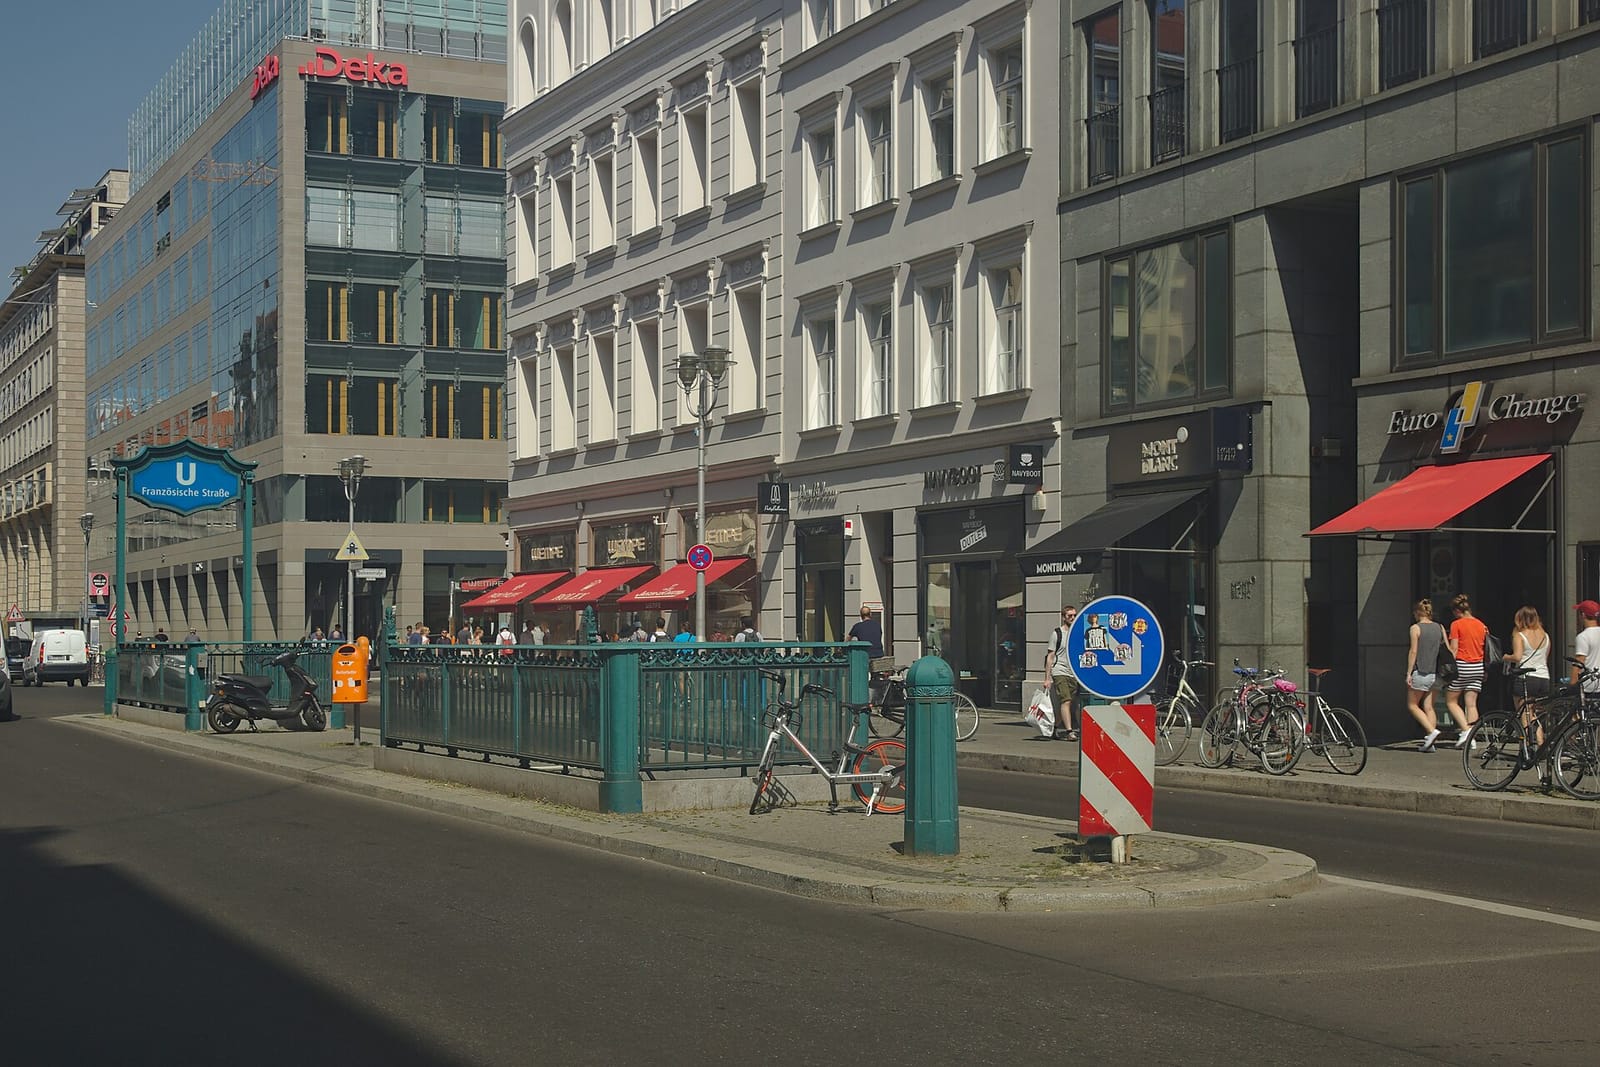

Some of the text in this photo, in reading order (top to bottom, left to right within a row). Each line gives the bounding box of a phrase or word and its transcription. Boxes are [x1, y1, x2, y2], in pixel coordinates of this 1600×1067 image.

[314, 47, 408, 86] Deka
[251, 55, 280, 100] Deka
[1387, 392, 1580, 435] Euro Change
[1141, 438, 1178, 458] MONT
[176, 462, 197, 486] U
[1011, 469, 1041, 478] NAVYBOOT
[1141, 455, 1178, 475] BLANC
[141, 486, 230, 498] Französische Straße
[961, 526, 986, 549] OUTLET
[531, 545, 564, 561] WEMPE
[1036, 561, 1077, 574] MONTBLANC
[467, 580, 505, 588] WEMPE
